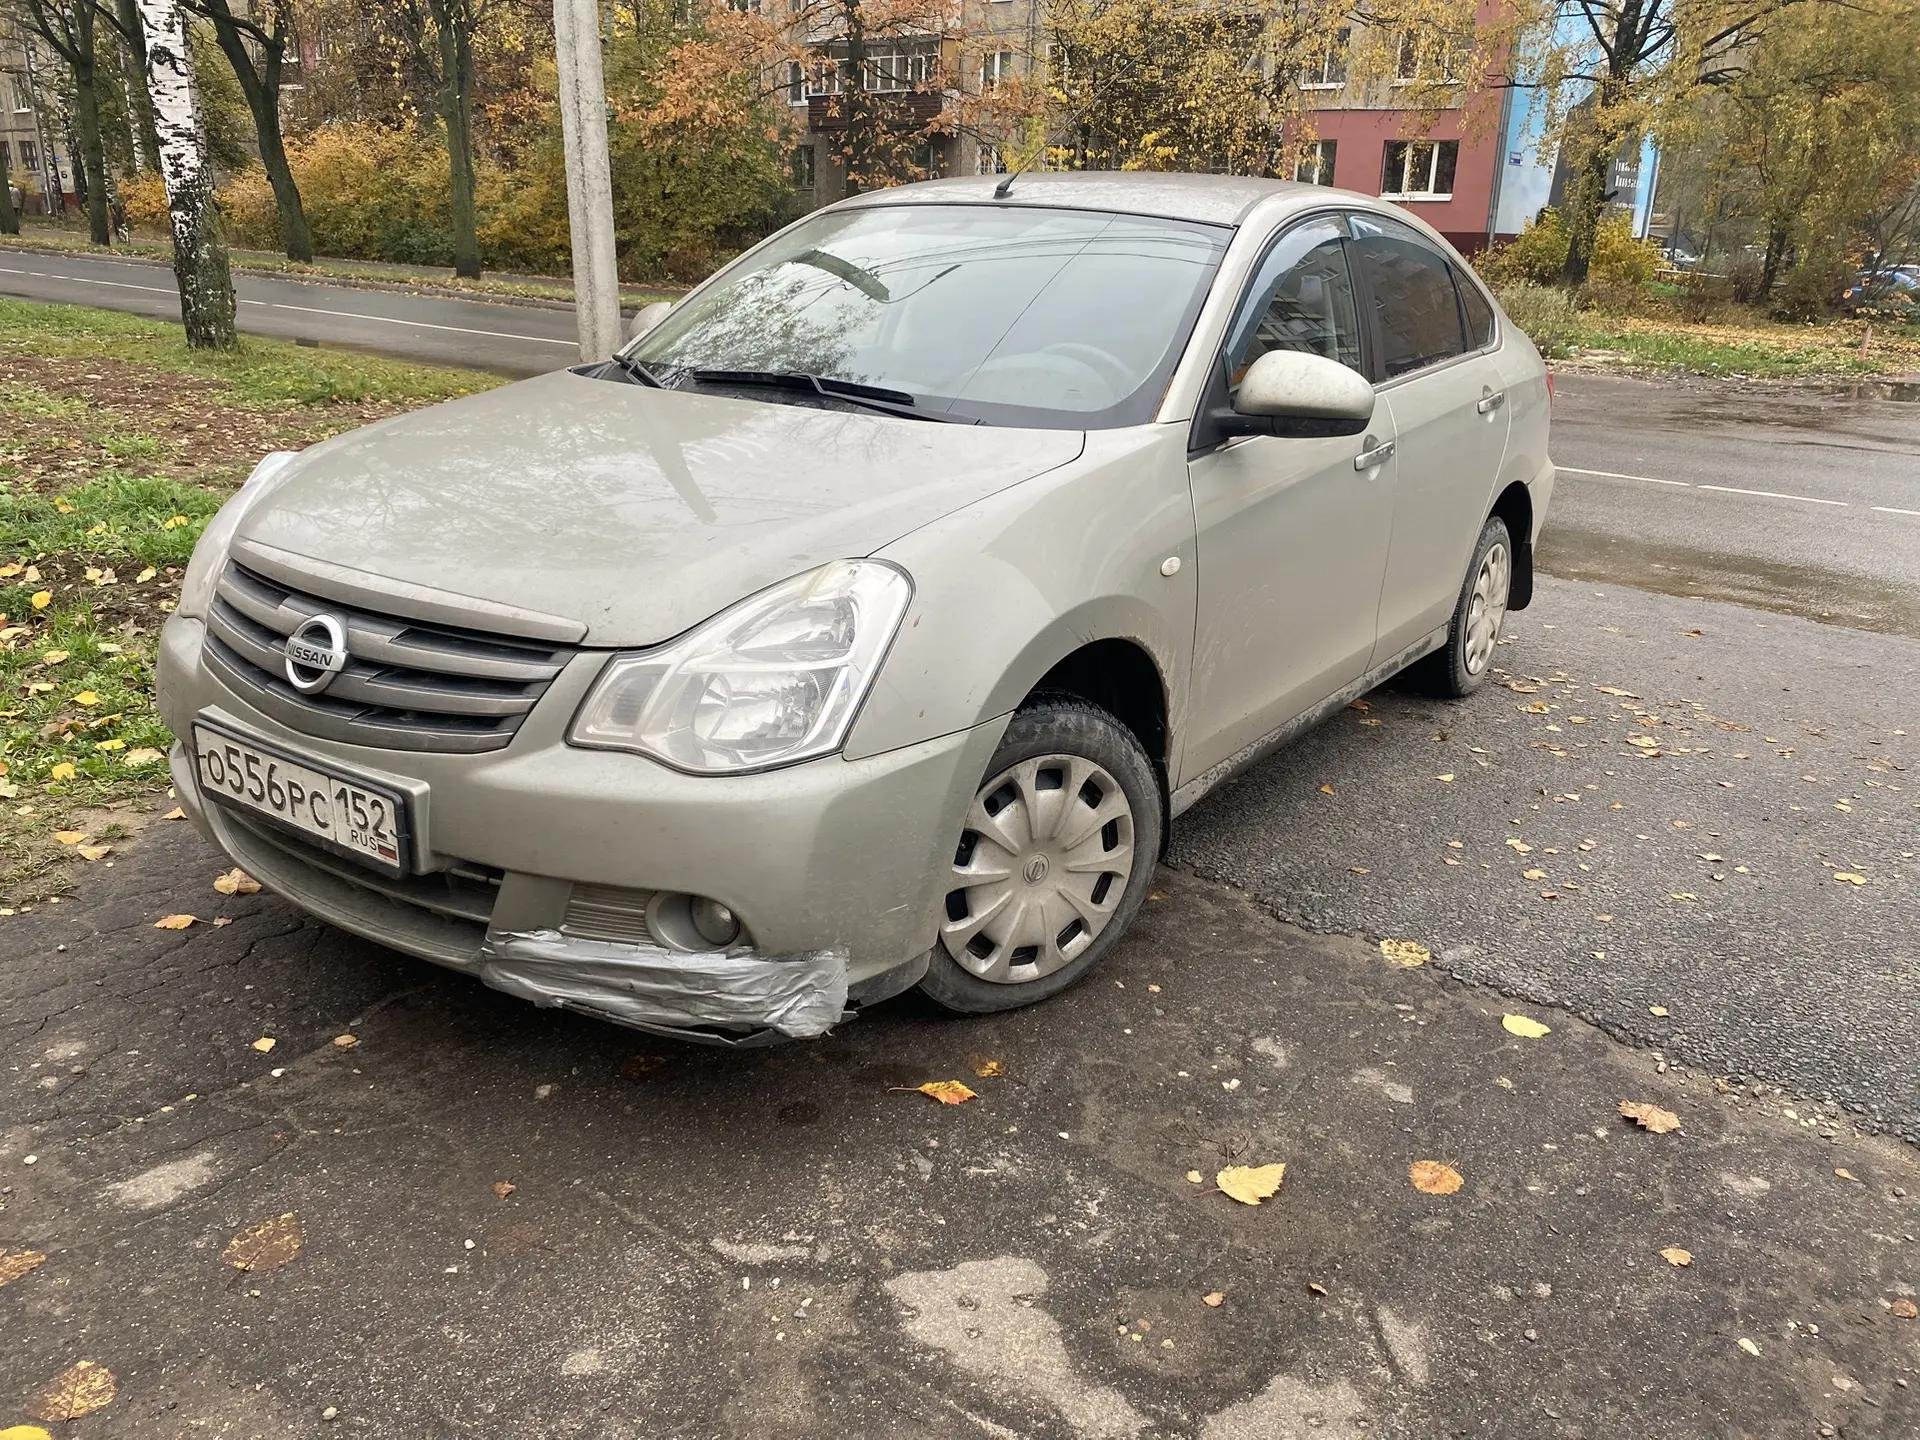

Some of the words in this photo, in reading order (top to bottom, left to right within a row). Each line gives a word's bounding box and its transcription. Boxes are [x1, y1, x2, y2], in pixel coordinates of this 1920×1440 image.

[287, 642, 333, 666] NISSAN
[207, 744, 330, 829] О556РС
[334, 786, 388, 840] 152
[351, 829, 377, 850] RUS
